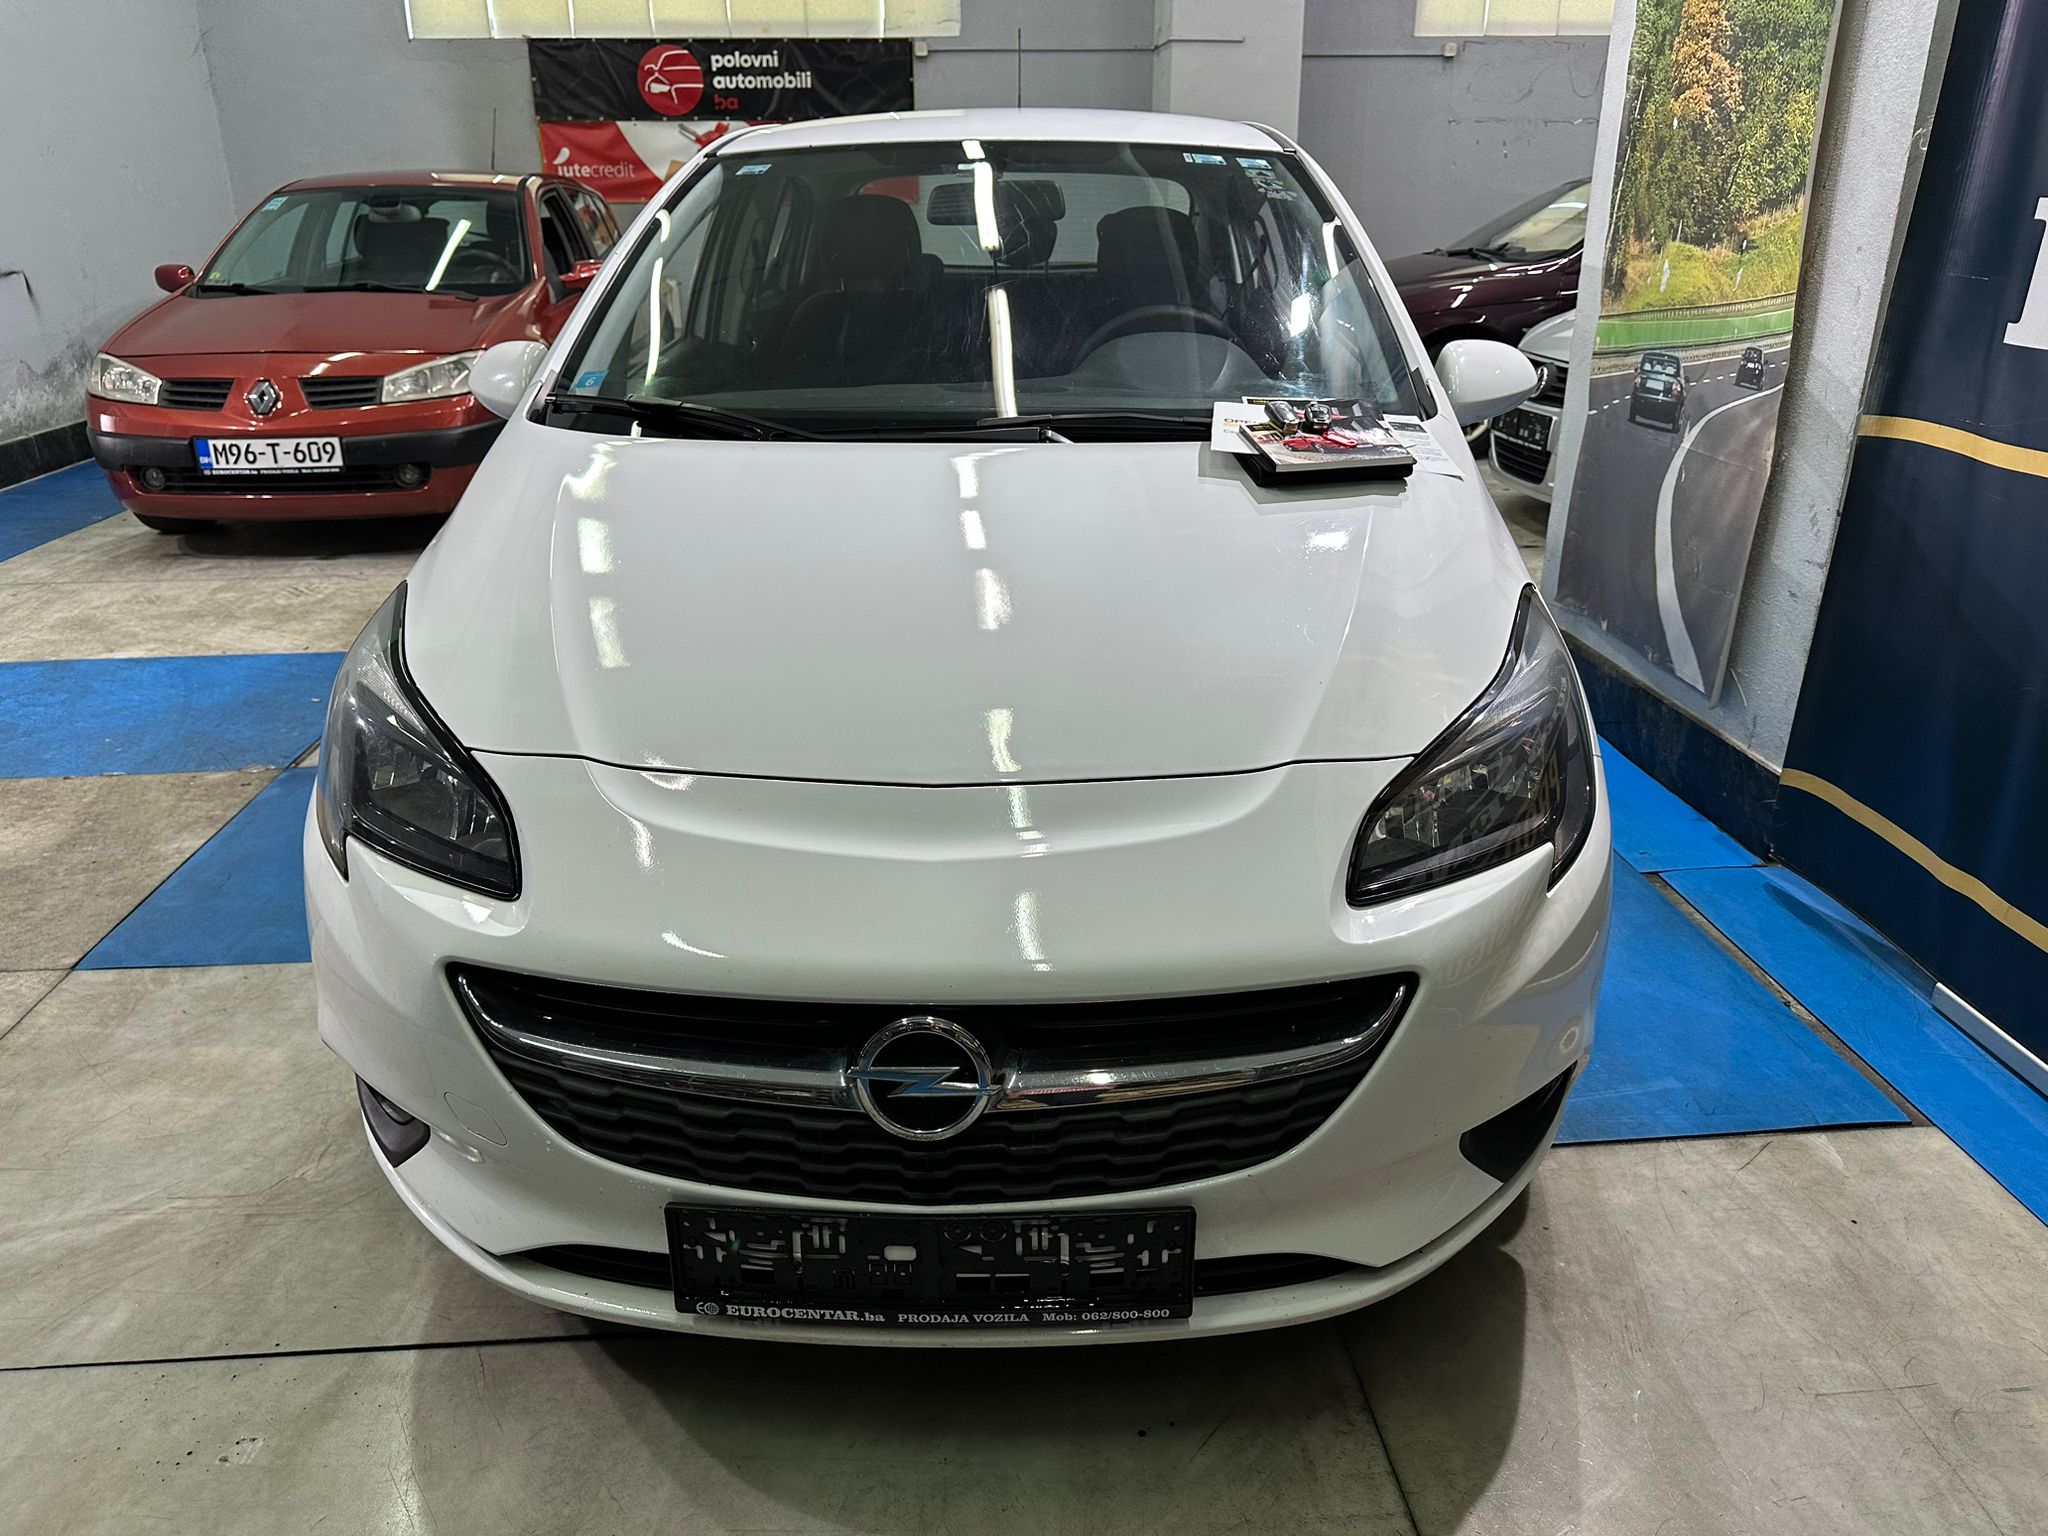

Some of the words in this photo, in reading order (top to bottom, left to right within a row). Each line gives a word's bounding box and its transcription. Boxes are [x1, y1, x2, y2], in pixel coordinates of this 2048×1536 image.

[710, 50, 779, 72] polovni
[712, 71, 812, 89] automobili
[212, 441, 336, 465] M96-T-609
[725, 1304, 886, 1322] EUROCENTAR.ba
[897, 1313, 969, 1324] PRODAJA
[973, 1313, 1030, 1323] VOZILA
[1042, 1312, 1078, 1322] Mob:
[1081, 1308, 1170, 1321] 062/800-800
